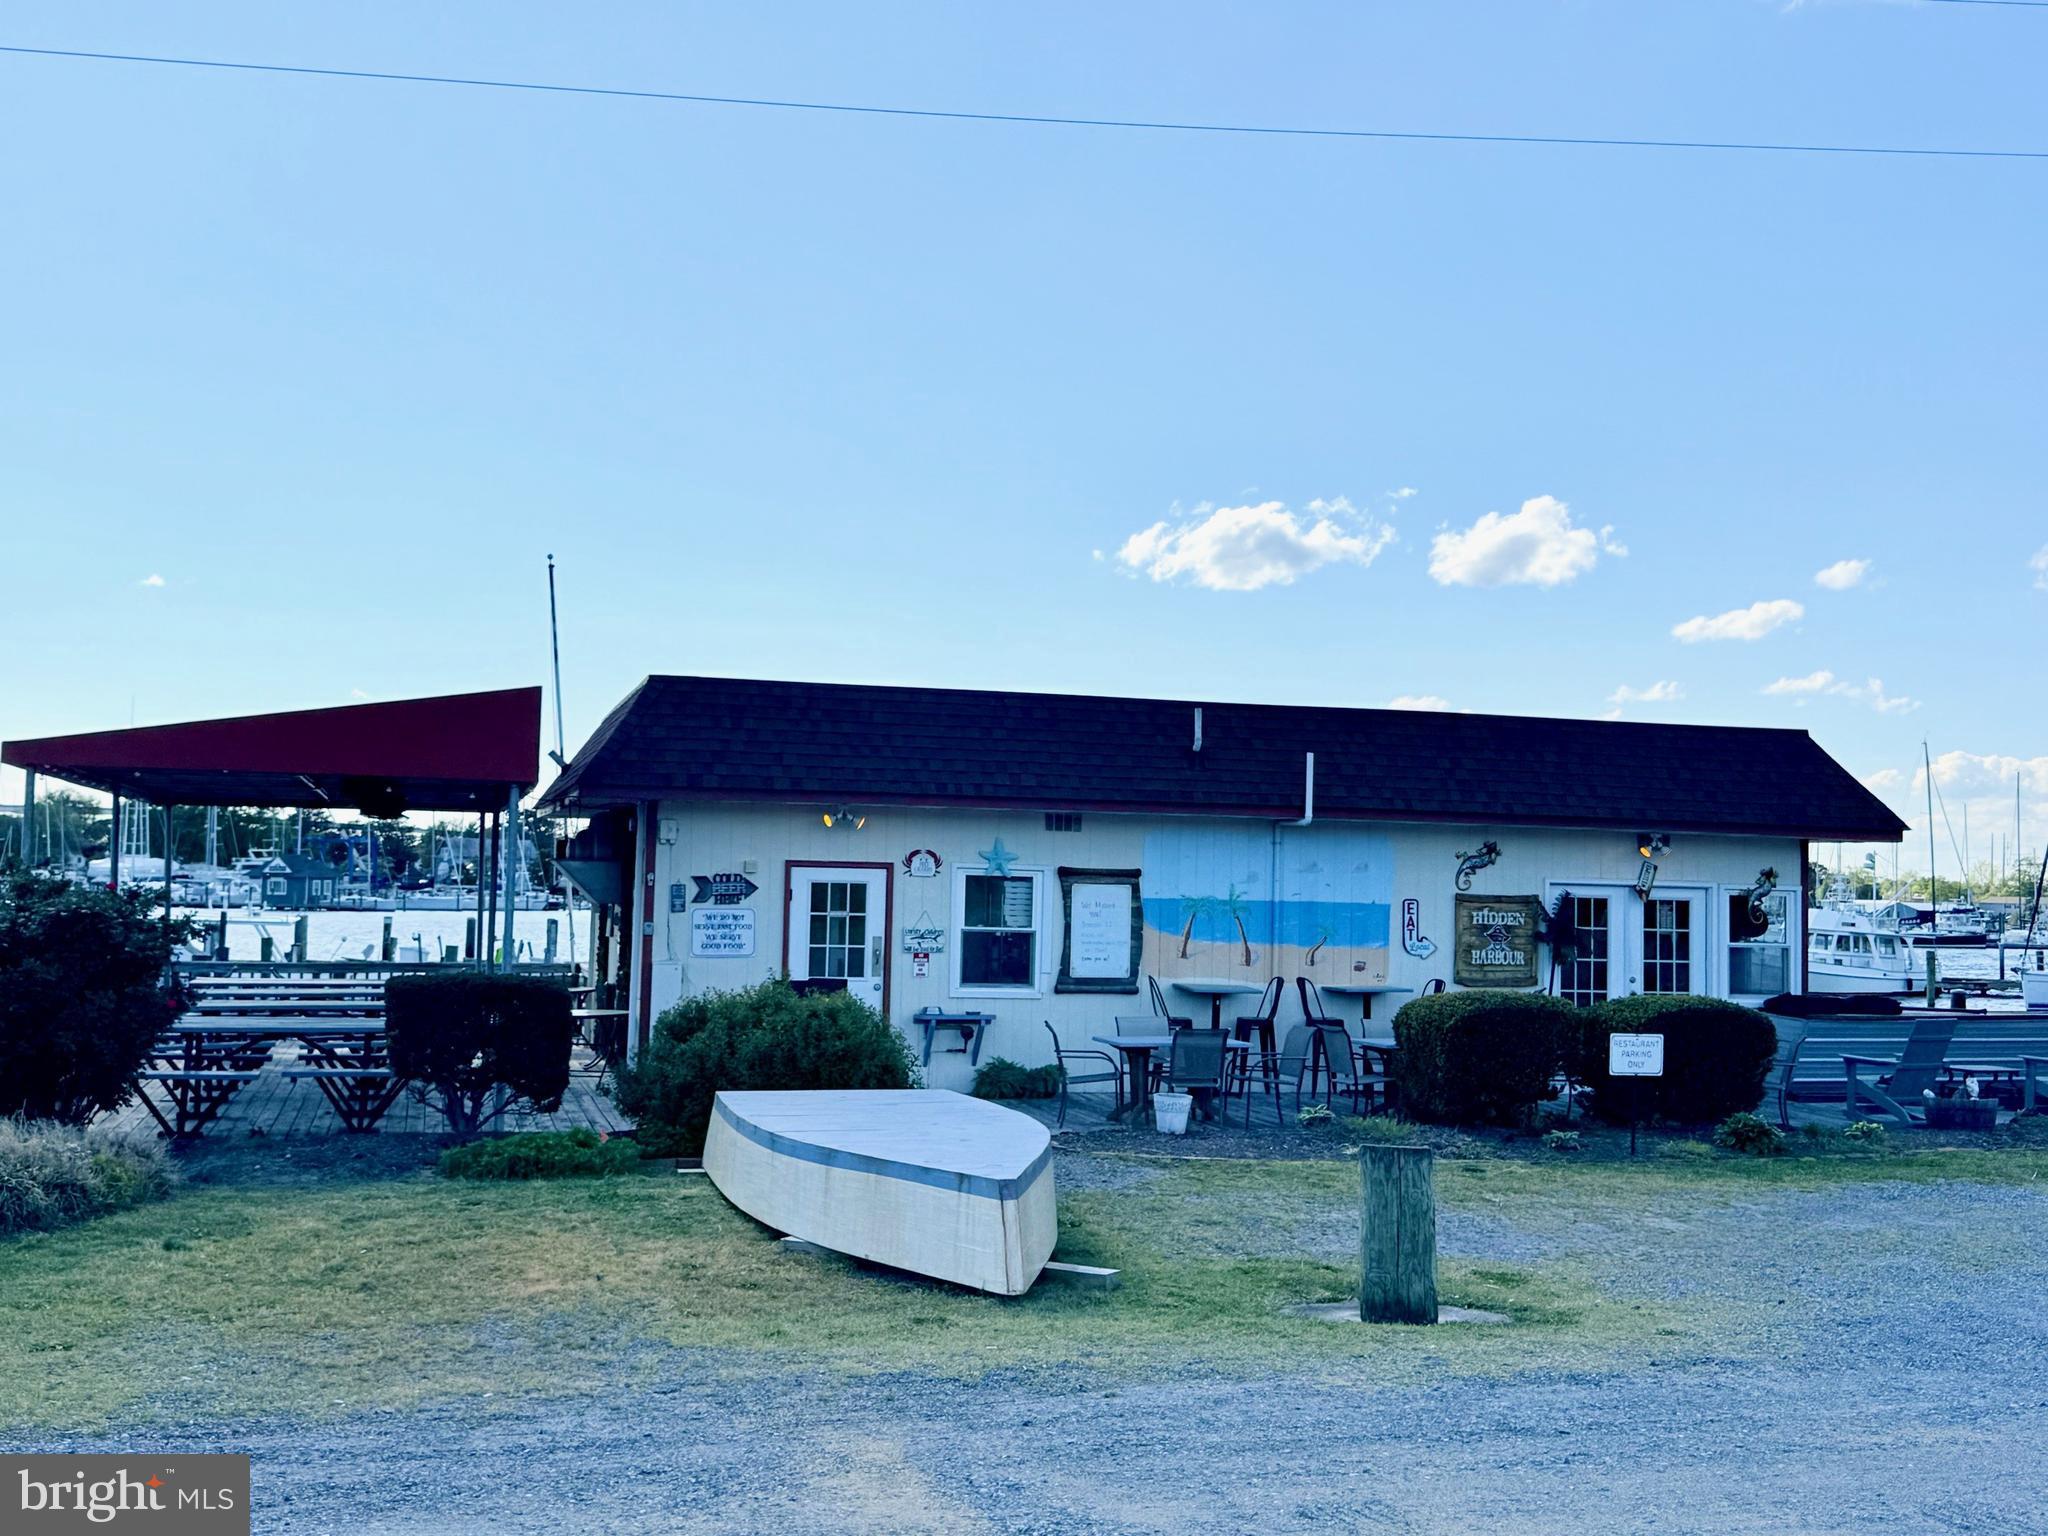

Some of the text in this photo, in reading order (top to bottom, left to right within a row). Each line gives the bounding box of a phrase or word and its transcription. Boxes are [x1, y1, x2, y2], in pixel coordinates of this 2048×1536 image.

[1406, 902, 1415, 941] EAT
[1471, 907, 1526, 925] HIDDEN
[1408, 942, 1431, 952] Local
[1471, 949, 1525, 965] HARBOUR
[1627, 1060, 1645, 1068] ONLY
